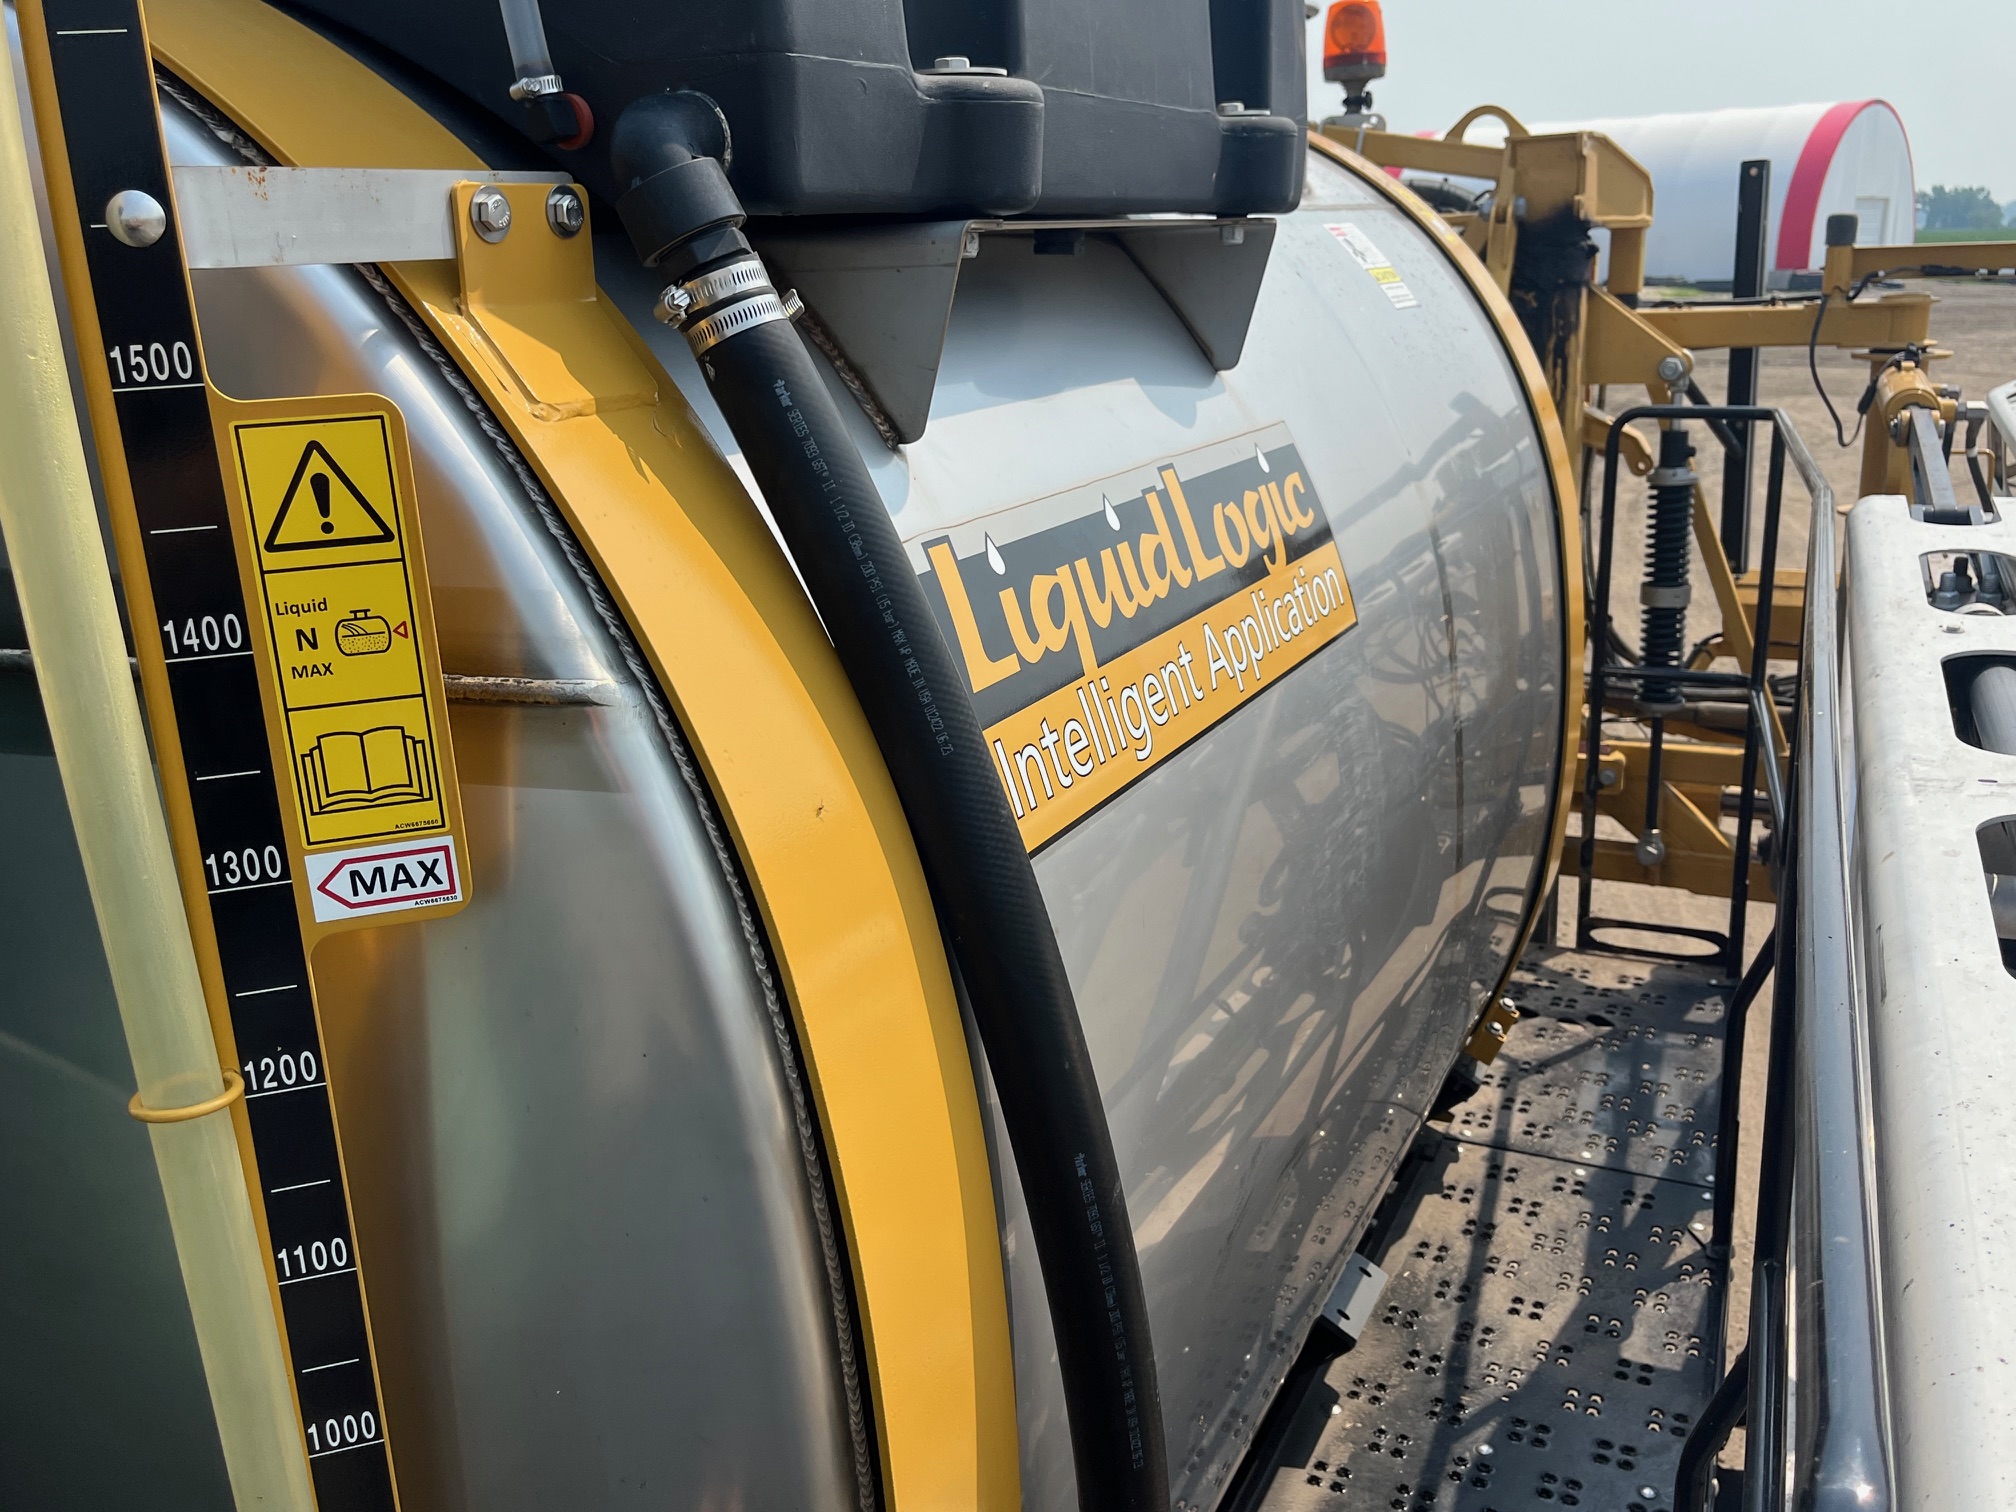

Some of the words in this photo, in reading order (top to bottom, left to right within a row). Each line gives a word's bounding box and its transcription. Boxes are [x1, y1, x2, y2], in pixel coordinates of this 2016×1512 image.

[109, 341, 193, 383] 1500
[773, 379, 793, 407] Parker
[787, 409, 810, 437] SERIES
[802, 436, 820, 458] 7093
[821, 479, 836, 492] II
[833, 504, 850, 521] 1/2
[841, 520, 855, 533] ID
[860, 560, 876, 578] 200
[928, 443, 1315, 694] LiquidLogic
[867, 576, 884, 593] PSI
[275, 597, 328, 617] Liquid
[876, 594, 892, 609] (15
[882, 608, 900, 629] bar)
[163, 613, 243, 654] 1400
[295, 627, 319, 652] N
[891, 628, 907, 646] MAX
[291, 662, 334, 680] MAX
[904, 656, 921, 678] MADE
[912, 677, 927, 689] IN
[993, 641, 1205, 820] Intelligent
[1202, 565, 1345, 692] Application
[918, 688, 932, 705] USA
[924, 704, 944, 733] 012422
[936, 732, 954, 756] 06:23
[205, 845, 282, 886] 1300
[349, 858, 444, 897] MAX
[244, 1051, 317, 1091] 1200
[277, 1237, 348, 1277] 1100
[308, 1411, 376, 1450] 1000
